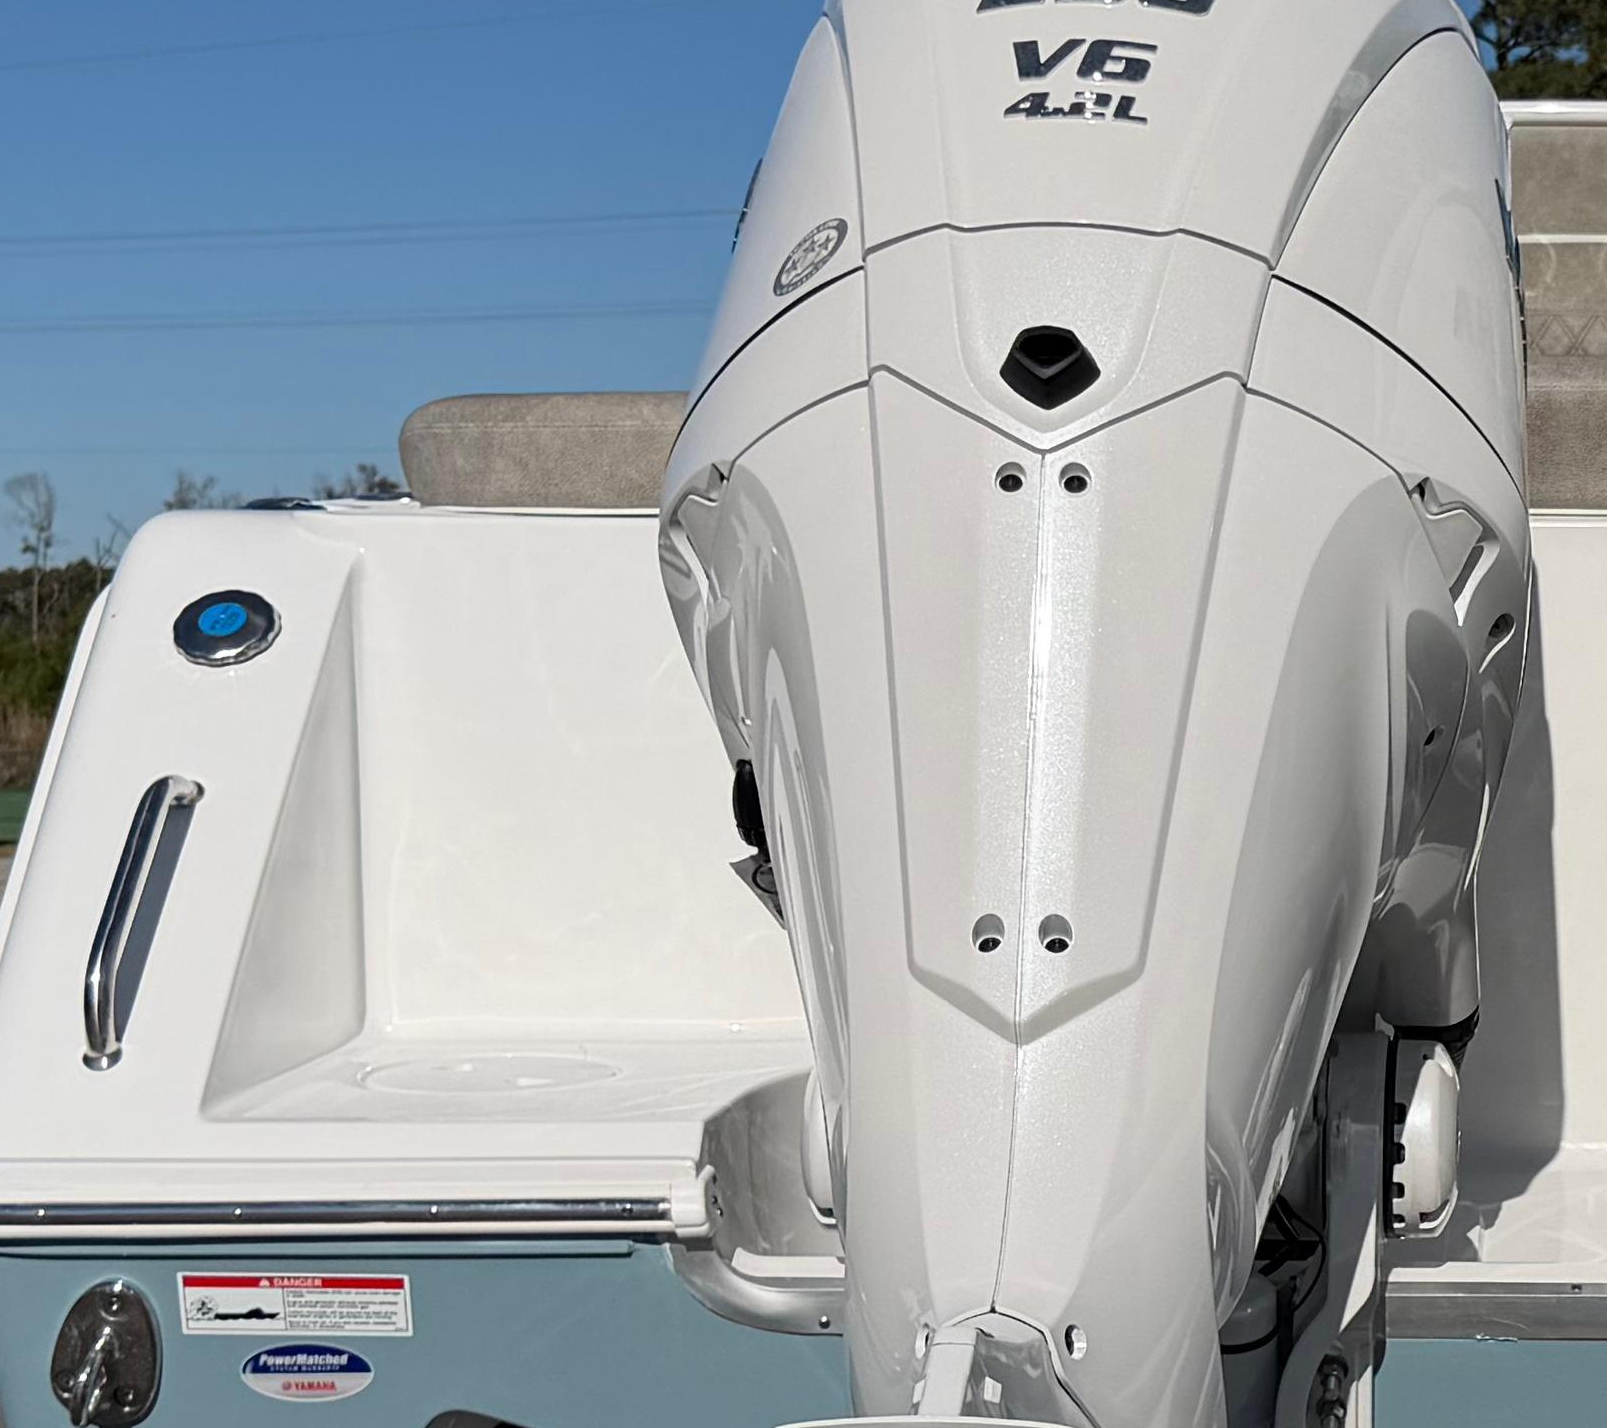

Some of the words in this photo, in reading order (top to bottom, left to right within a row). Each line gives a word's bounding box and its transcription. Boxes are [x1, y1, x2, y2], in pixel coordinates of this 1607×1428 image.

[1012, 38, 1159, 84] V6
[1003, 91, 1150, 126] 4.2L
[273, 1277, 323, 1287] DANGER
[259, 1353, 349, 1366] PowerMatched
